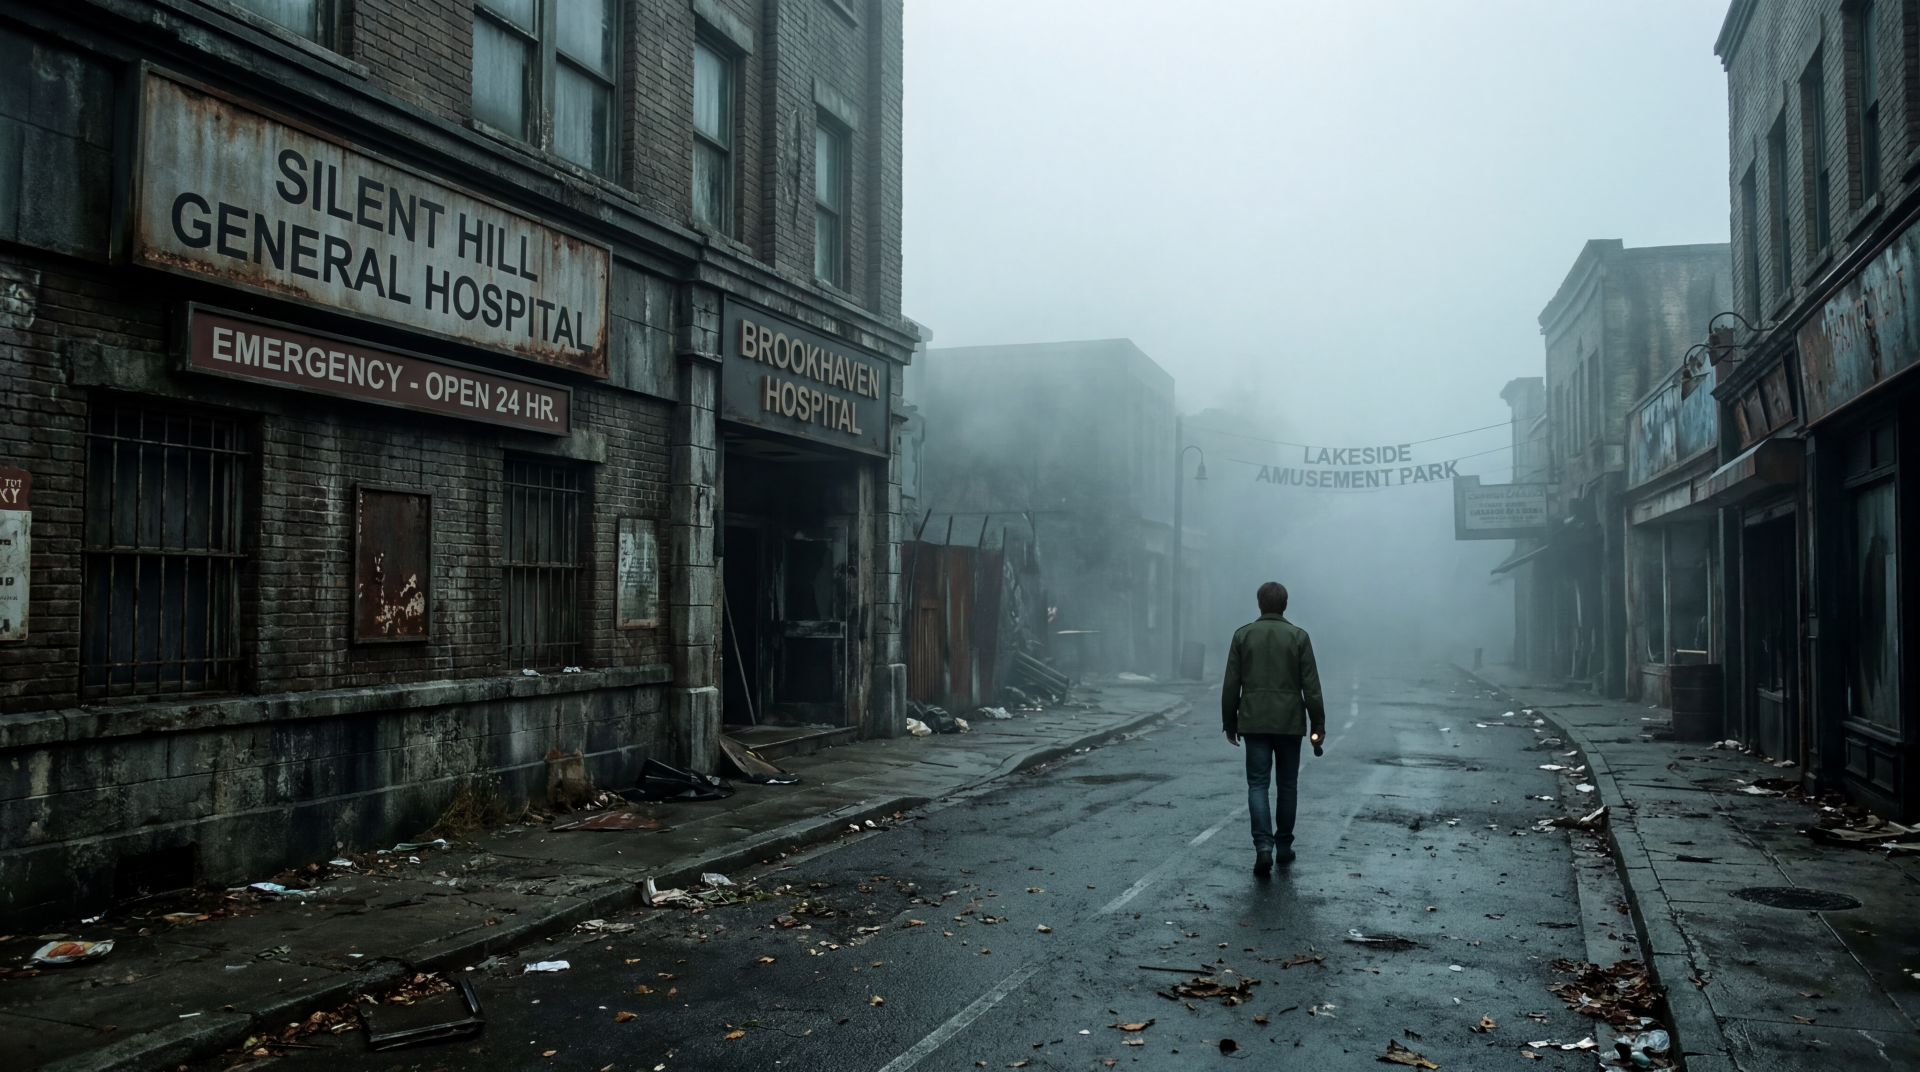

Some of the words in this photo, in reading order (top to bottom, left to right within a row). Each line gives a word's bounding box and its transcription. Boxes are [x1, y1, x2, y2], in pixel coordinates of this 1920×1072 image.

[276, 149, 445, 249] SILENT
[458, 213, 539, 282] HILL
[172, 192, 411, 305] GENERAL
[425, 264, 593, 352] HOSPITAL
[212, 326, 403, 394] EMERGENCY
[425, 371, 490, 411] OPEN
[496, 386, 521, 415] 24
[526, 392, 560, 423] HR.
[739, 320, 880, 400] BROOKHAVEN
[764, 376, 862, 435] HOSPITAL
[1256, 464, 1393, 488] AMUSEMENT
[1401, 461, 1460, 485] PARK
[1304, 444, 1412, 465] LAKESIDE
